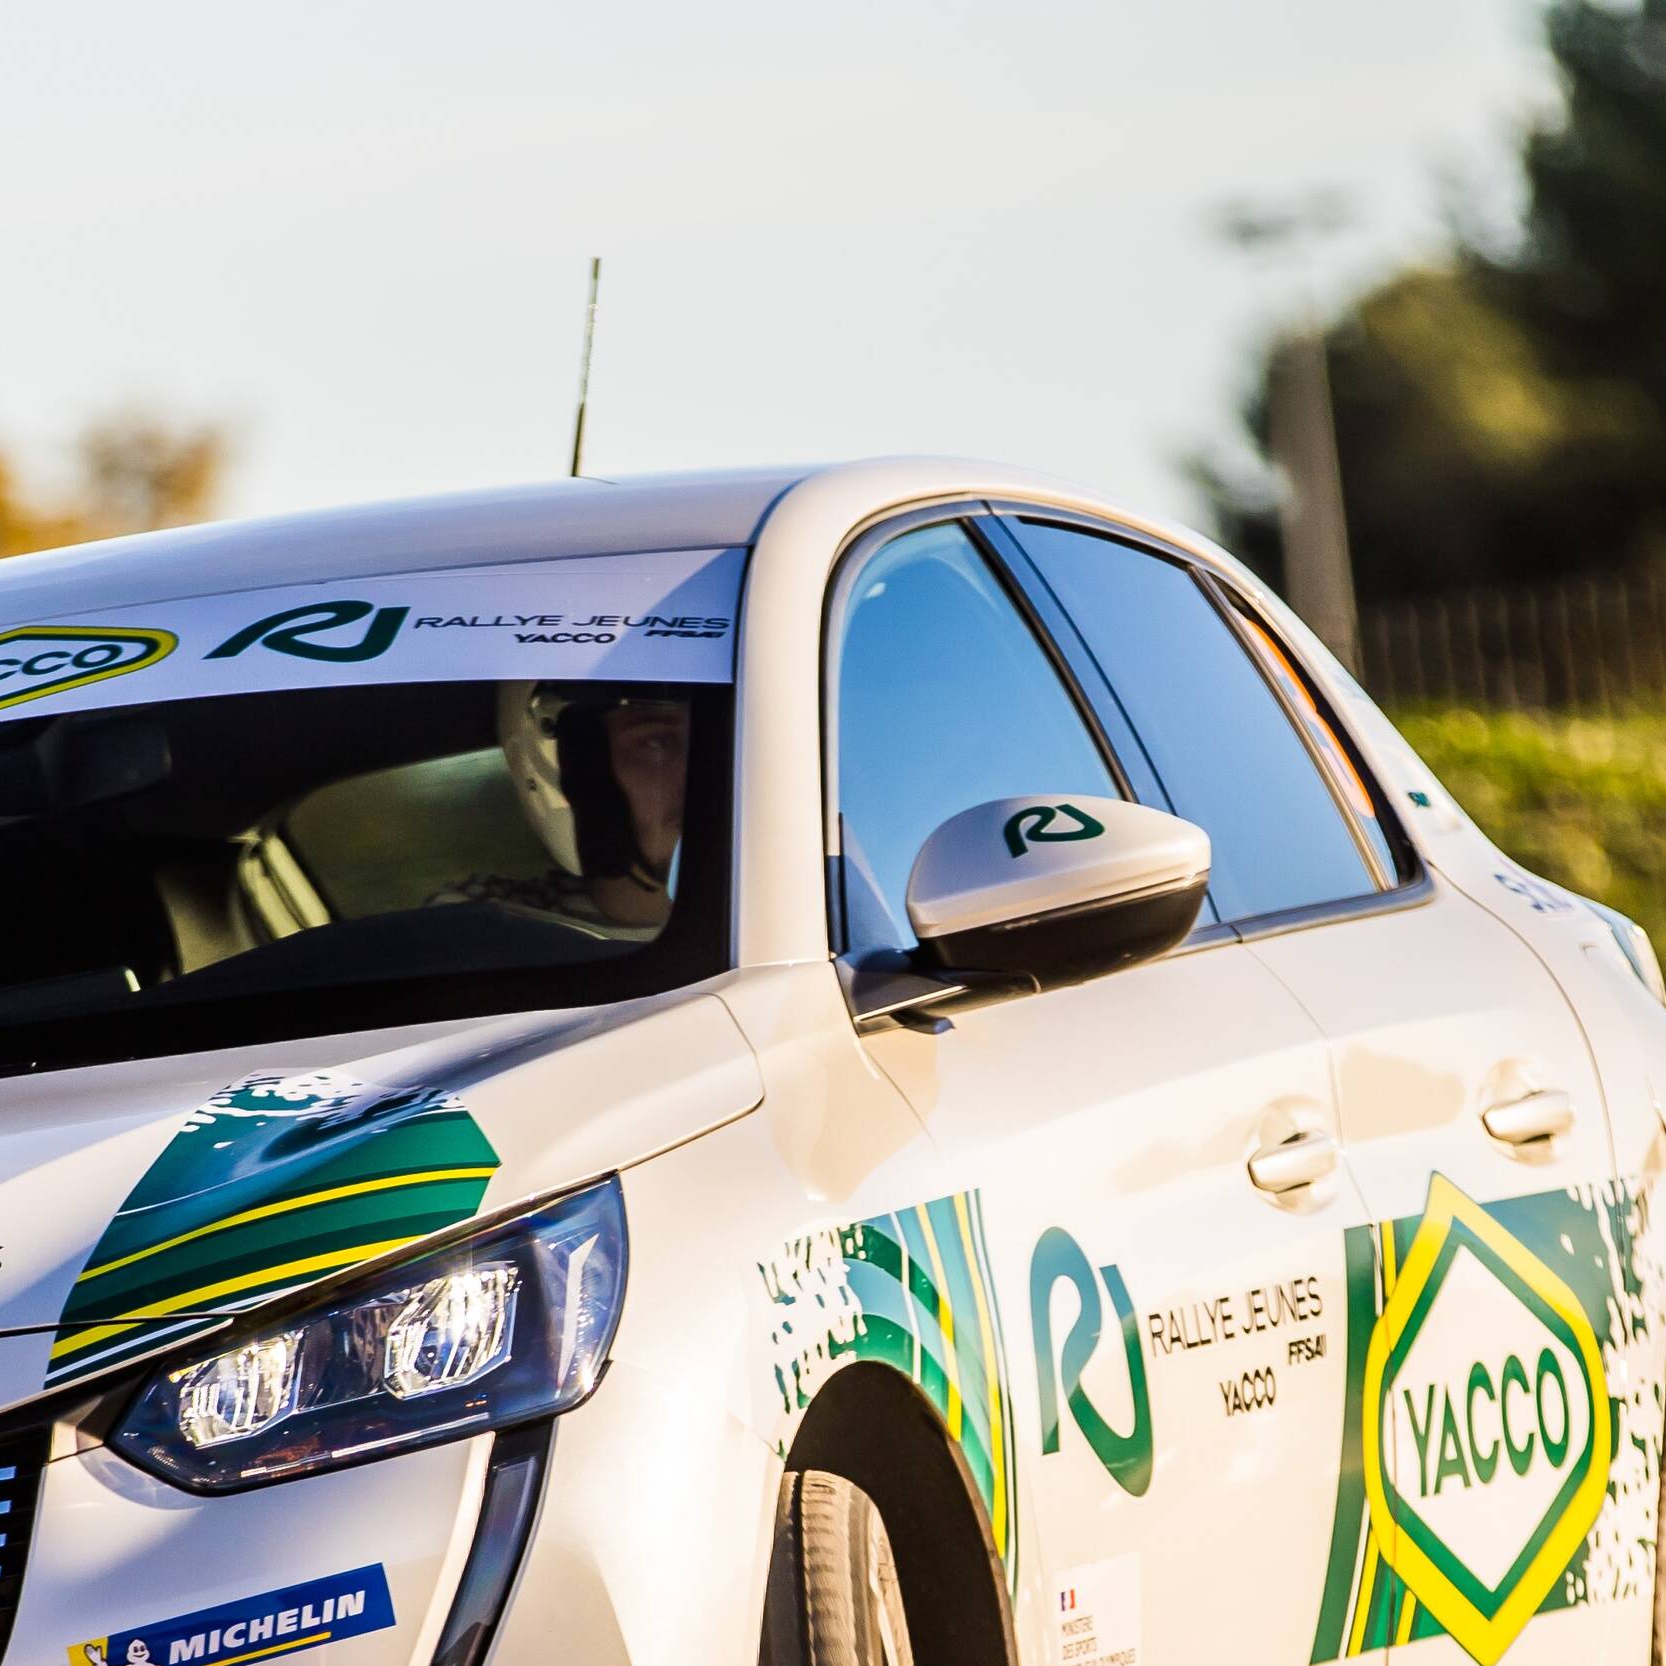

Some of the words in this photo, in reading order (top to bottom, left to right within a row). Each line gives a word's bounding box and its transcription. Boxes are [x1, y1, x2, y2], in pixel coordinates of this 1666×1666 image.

[413, 614, 565, 629] RALLYE
[572, 614, 730, 629] JEUNES
[513, 632, 616, 644] YACCO
[1148, 1296, 1235, 1358] RALLYE
[1242, 1276, 1325, 1335] JEUNES
[1219, 1366, 1277, 1417] YACCO
[1403, 1347, 1570, 1497] YACCO
[168, 1589, 367, 1666] MICHELIN
